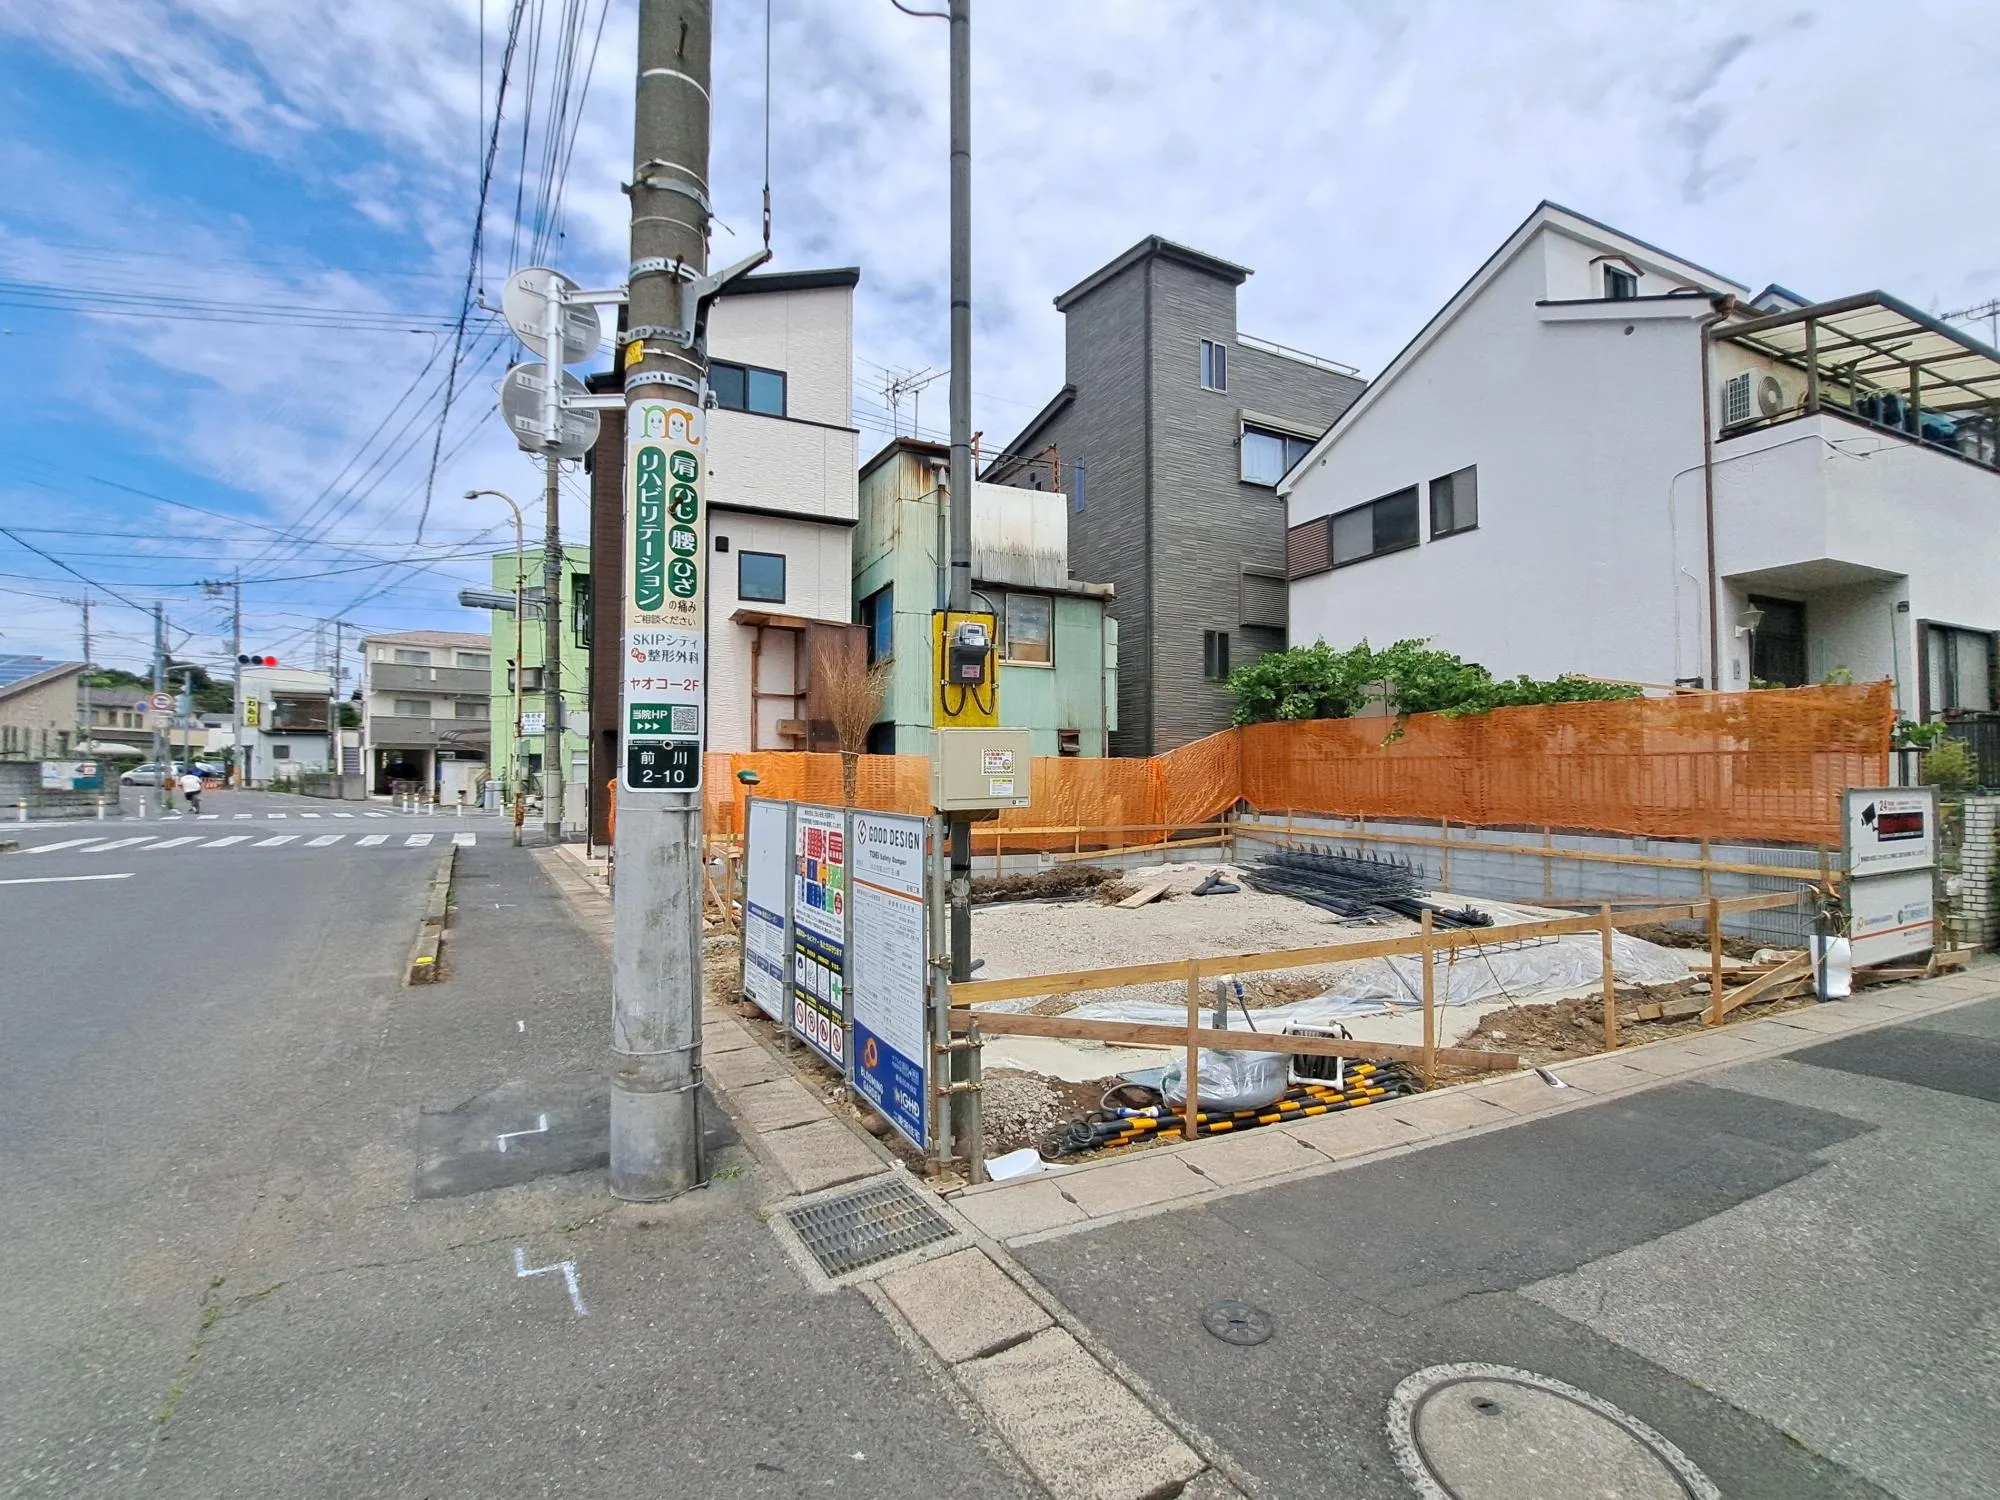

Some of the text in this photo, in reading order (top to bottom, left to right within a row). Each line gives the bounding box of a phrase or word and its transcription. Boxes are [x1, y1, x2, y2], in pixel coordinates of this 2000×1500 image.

[638, 455, 662, 606] リハビリテーション
[669, 600, 697, 614] の痛み
[634, 614, 696, 626] ご相談ください
[633, 633, 698, 649] SKIPシティ
[648, 649, 699, 664] 整形外科
[630, 677, 700, 691] ヤオコー2F
[632, 709, 668, 720] 当院HP
[642, 769, 685, 783] 2-10
[869, 825, 920, 850] GOOD DESIGN
